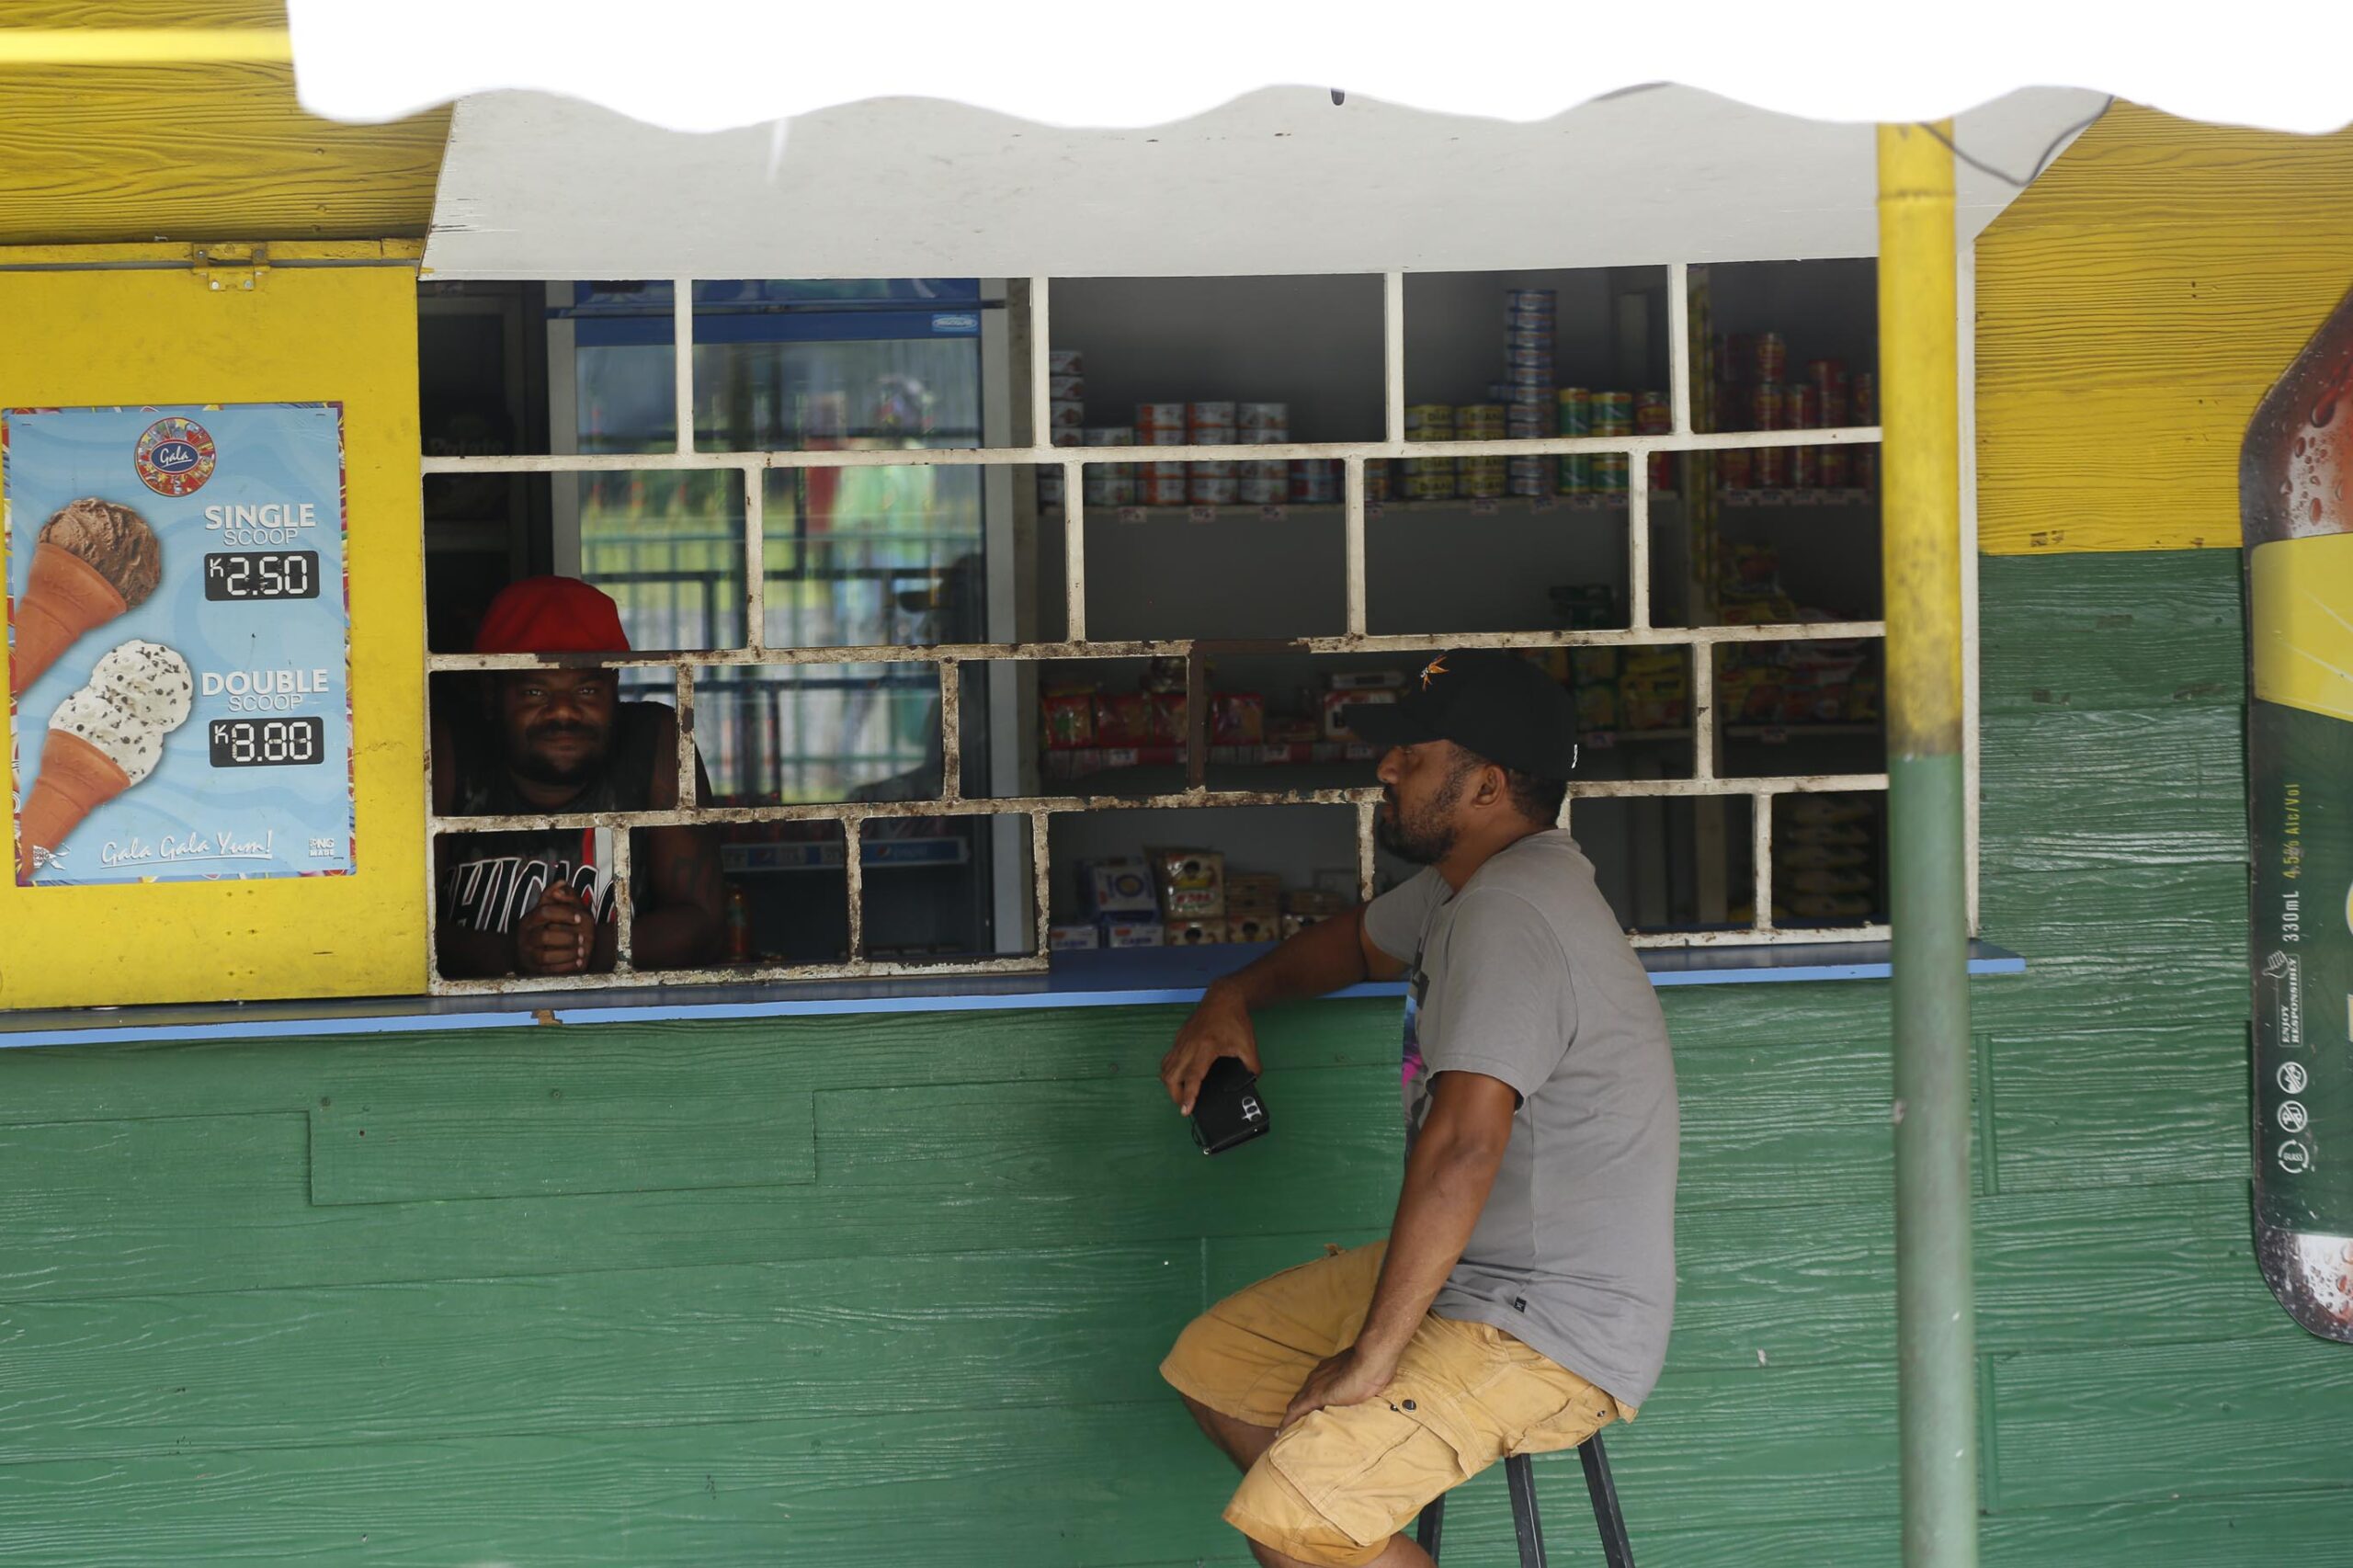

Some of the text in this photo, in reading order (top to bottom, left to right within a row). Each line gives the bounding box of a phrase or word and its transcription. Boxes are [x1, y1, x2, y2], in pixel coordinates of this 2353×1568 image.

[159, 436, 189, 461] Gala
[204, 503, 316, 530] SINGLE
[222, 528, 299, 547] SCOOP
[200, 668, 330, 697] DOUBLE
[228, 693, 303, 712] SCOOP
[2283, 782, 2301, 835] Alc/Vol
[101, 836, 152, 866] Gala
[159, 831, 211, 860] Gala
[217, 829, 273, 854] Yum!
[2281, 890, 2301, 943] 330mL
[2289, 958, 2300, 1044] RESPONSIBLY
[2280, 1004, 2290, 1044] ENJOY
